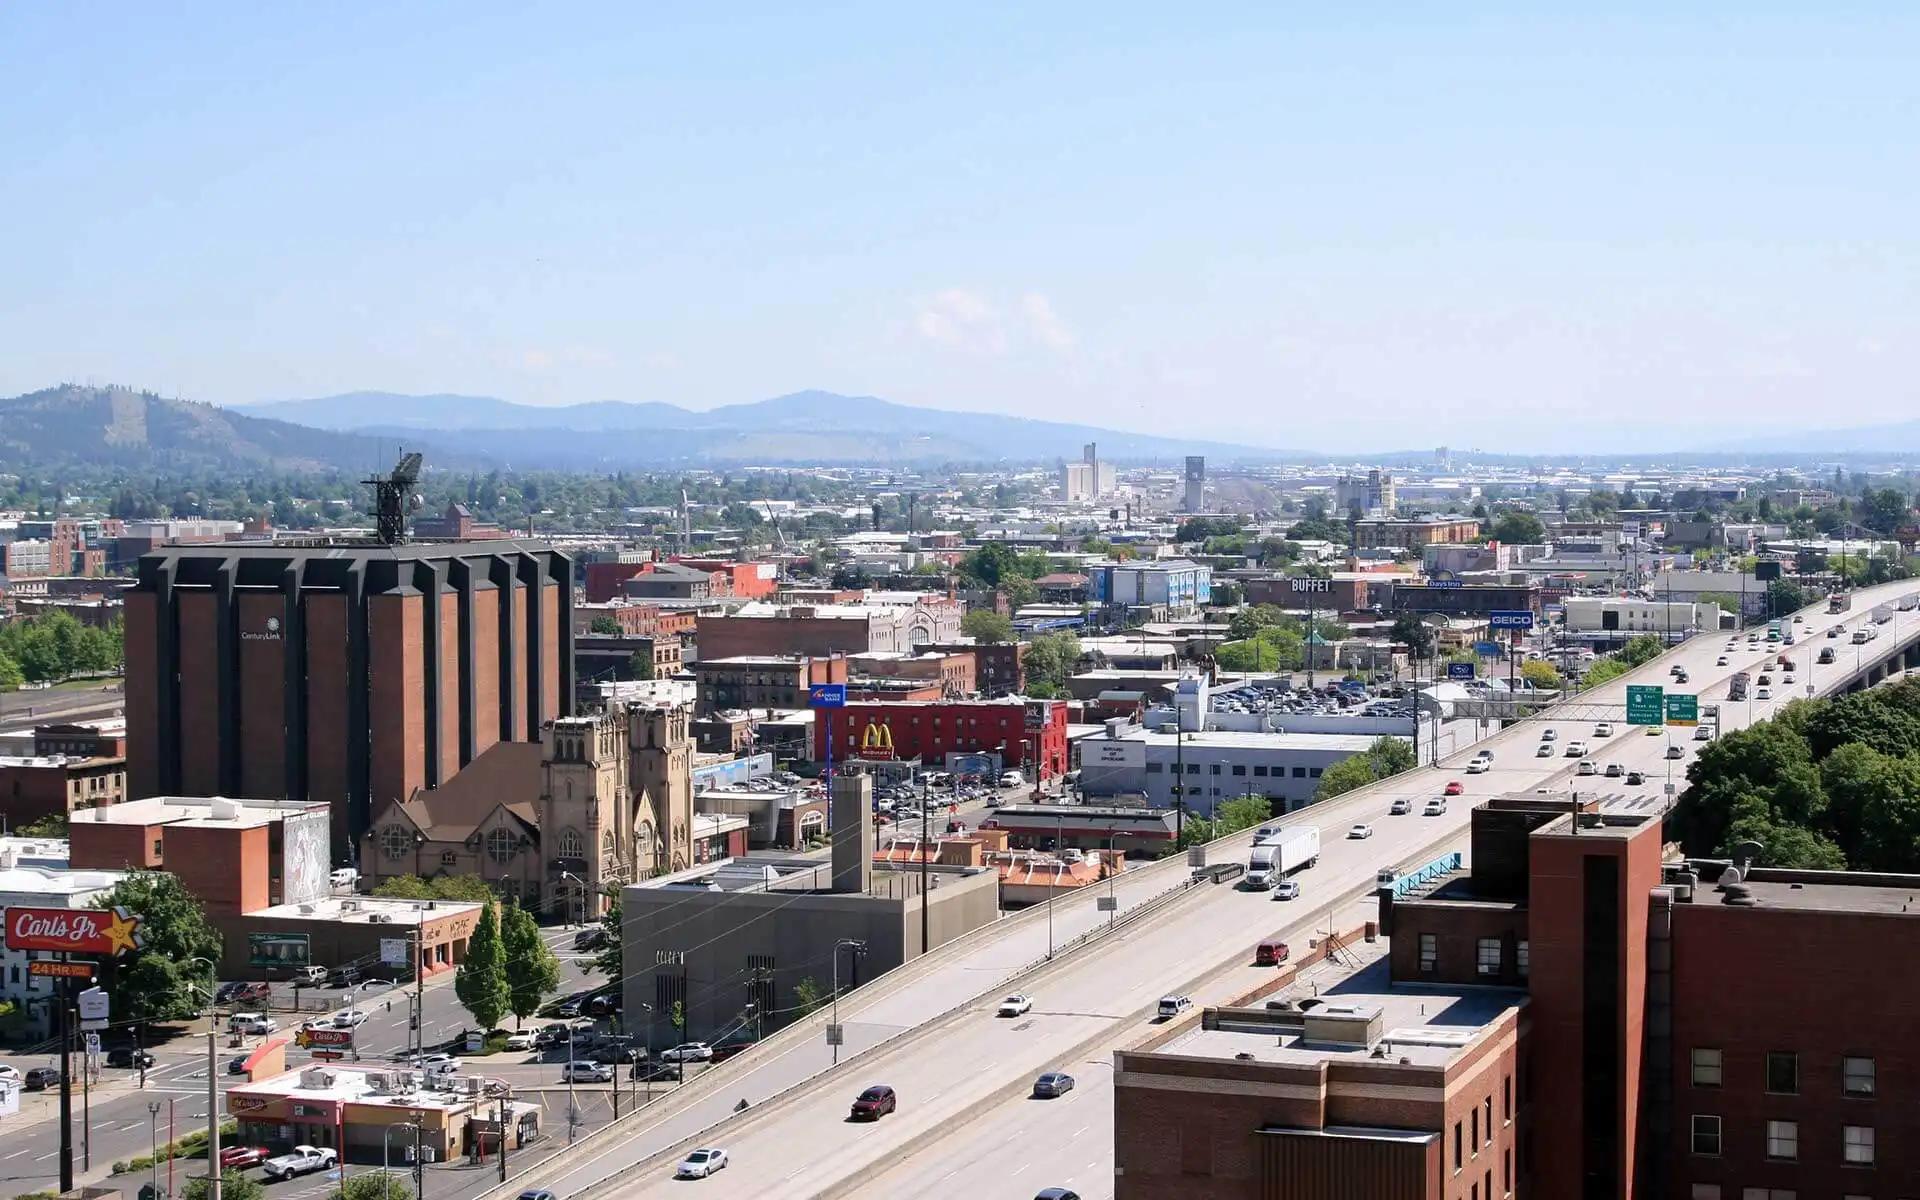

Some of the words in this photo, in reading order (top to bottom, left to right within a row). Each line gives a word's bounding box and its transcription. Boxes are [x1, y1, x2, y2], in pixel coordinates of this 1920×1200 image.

[1291, 578, 1330, 592] BUFFET
[1492, 615, 1531, 625] GEICO
[241, 631, 280, 640] CenturyLink
[15, 913, 69, 938] Carl's
[69, 915, 101, 940] Jr.
[31, 963, 49, 974] 24
